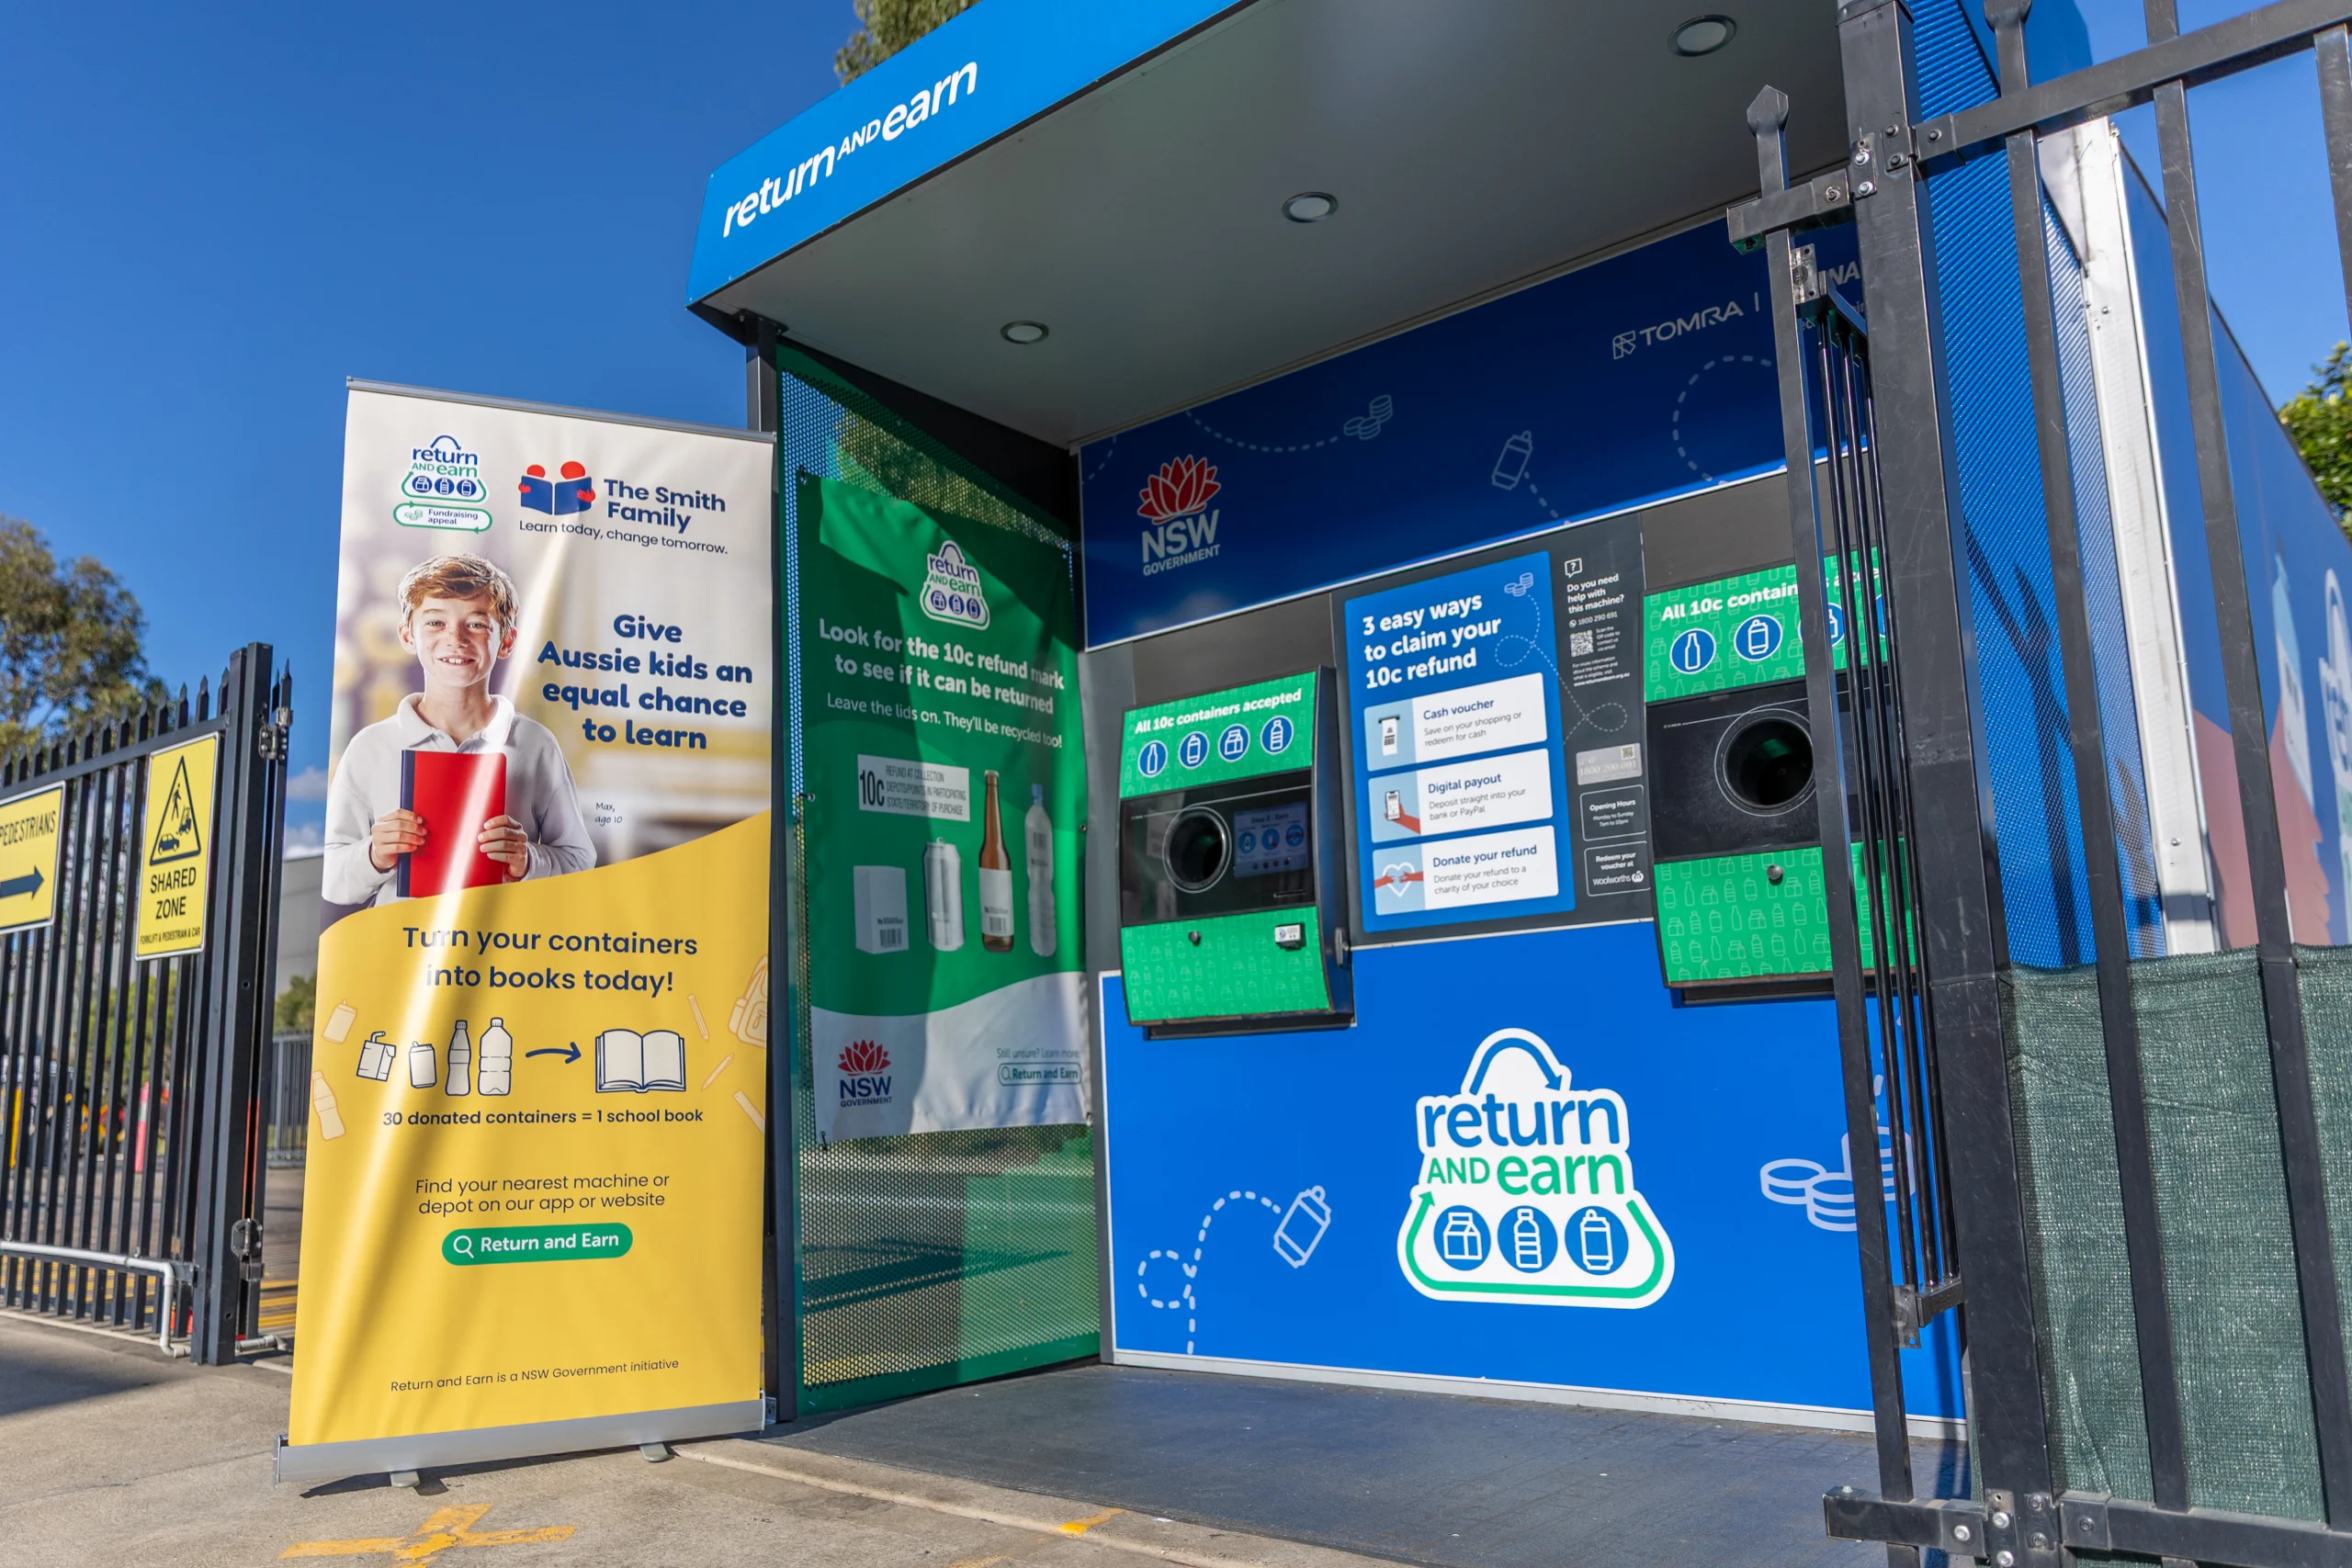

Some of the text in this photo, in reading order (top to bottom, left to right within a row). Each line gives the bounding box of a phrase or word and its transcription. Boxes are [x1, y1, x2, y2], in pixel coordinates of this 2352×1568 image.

[723, 62, 978, 238] return AND earn
[1640, 301, 1744, 345] TOMRA
[413, 445, 479, 465] return
[412, 462, 479, 477] AND earn
[604, 479, 725, 511] The Smith
[428, 508, 479, 520] Fundraising
[428, 516, 458, 525] appeal
[608, 502, 692, 534] Family
[520, 520, 728, 553] Learn today, change tomorrow.
[1142, 509, 1220, 563] NSW
[929, 556, 978, 581] return
[1143, 544, 1221, 576] GOVERNMENT
[929, 574, 980, 596] AND earn
[1580, 580, 1597, 590] you
[1598, 573, 1619, 584] need
[1567, 588, 1606, 603] help with
[1568, 594, 1624, 613] this machine?
[1363, 595, 1482, 635] 3 easy ways
[1662, 604, 1687, 622] All
[1690, 598, 1724, 616] 10c
[614, 615, 683, 643] Give
[1364, 618, 1501, 660] to claim your
[537, 641, 752, 682] Aussie kids an
[820, 618, 1066, 690] Look for the 10c refund mark
[1366, 648, 1476, 688] 10c refund
[835, 654, 1053, 714] to see if it can be returned
[543, 683, 747, 716] equal chance
[1135, 688, 1302, 733] All 10c containers accepted
[1423, 700, 1494, 719] Cash voucher
[828, 693, 1062, 747] Leave the lids on. They'll be recycled too!
[582, 718, 707, 749] to learn
[860, 770, 885, 806] 10c
[1428, 774, 1501, 794] Digital payout
[595, 802, 616, 812] Max,
[1429, 798, 1458, 808] Deposit
[1460, 794, 1488, 804] straight
[1508, 789, 1525, 798] your
[1589, 803, 1616, 811] Opening
[595, 814, 623, 826] age 10
[1460, 806, 1485, 816] PayPal
[1433, 844, 1537, 866] Donate your refund
[151, 867, 197, 894] SHARED
[1434, 886, 1460, 894] charity
[1472, 882, 1489, 891] your
[1593, 874, 1632, 886] woolworths
[156, 897, 187, 919] ZONE
[477, 931, 543, 956] your
[548, 932, 697, 954] containers
[426, 964, 673, 997] into books today!
[1012, 1067, 1079, 1079] Return and Earn
[840, 1076, 893, 1099] NSW
[840, 1098, 893, 1108] GOVERNMENT
[383, 1109, 703, 1124] 30 donated containers 1 school book
[1425, 1094, 1621, 1147] return
[416, 1173, 670, 1196] Find your nearest machine or
[1428, 1155, 1625, 1195] AND earn
[419, 1192, 665, 1216] depot on our app or website
[481, 1233, 618, 1251] Return and Earn
[391, 1381, 433, 1390] Return
[436, 1376, 461, 1387] and
[466, 1375, 492, 1384] Earn
[497, 1372, 506, 1382] is
[522, 1370, 549, 1379] NSW
[552, 1363, 627, 1377] Government
[631, 1360, 679, 1371] initiative
